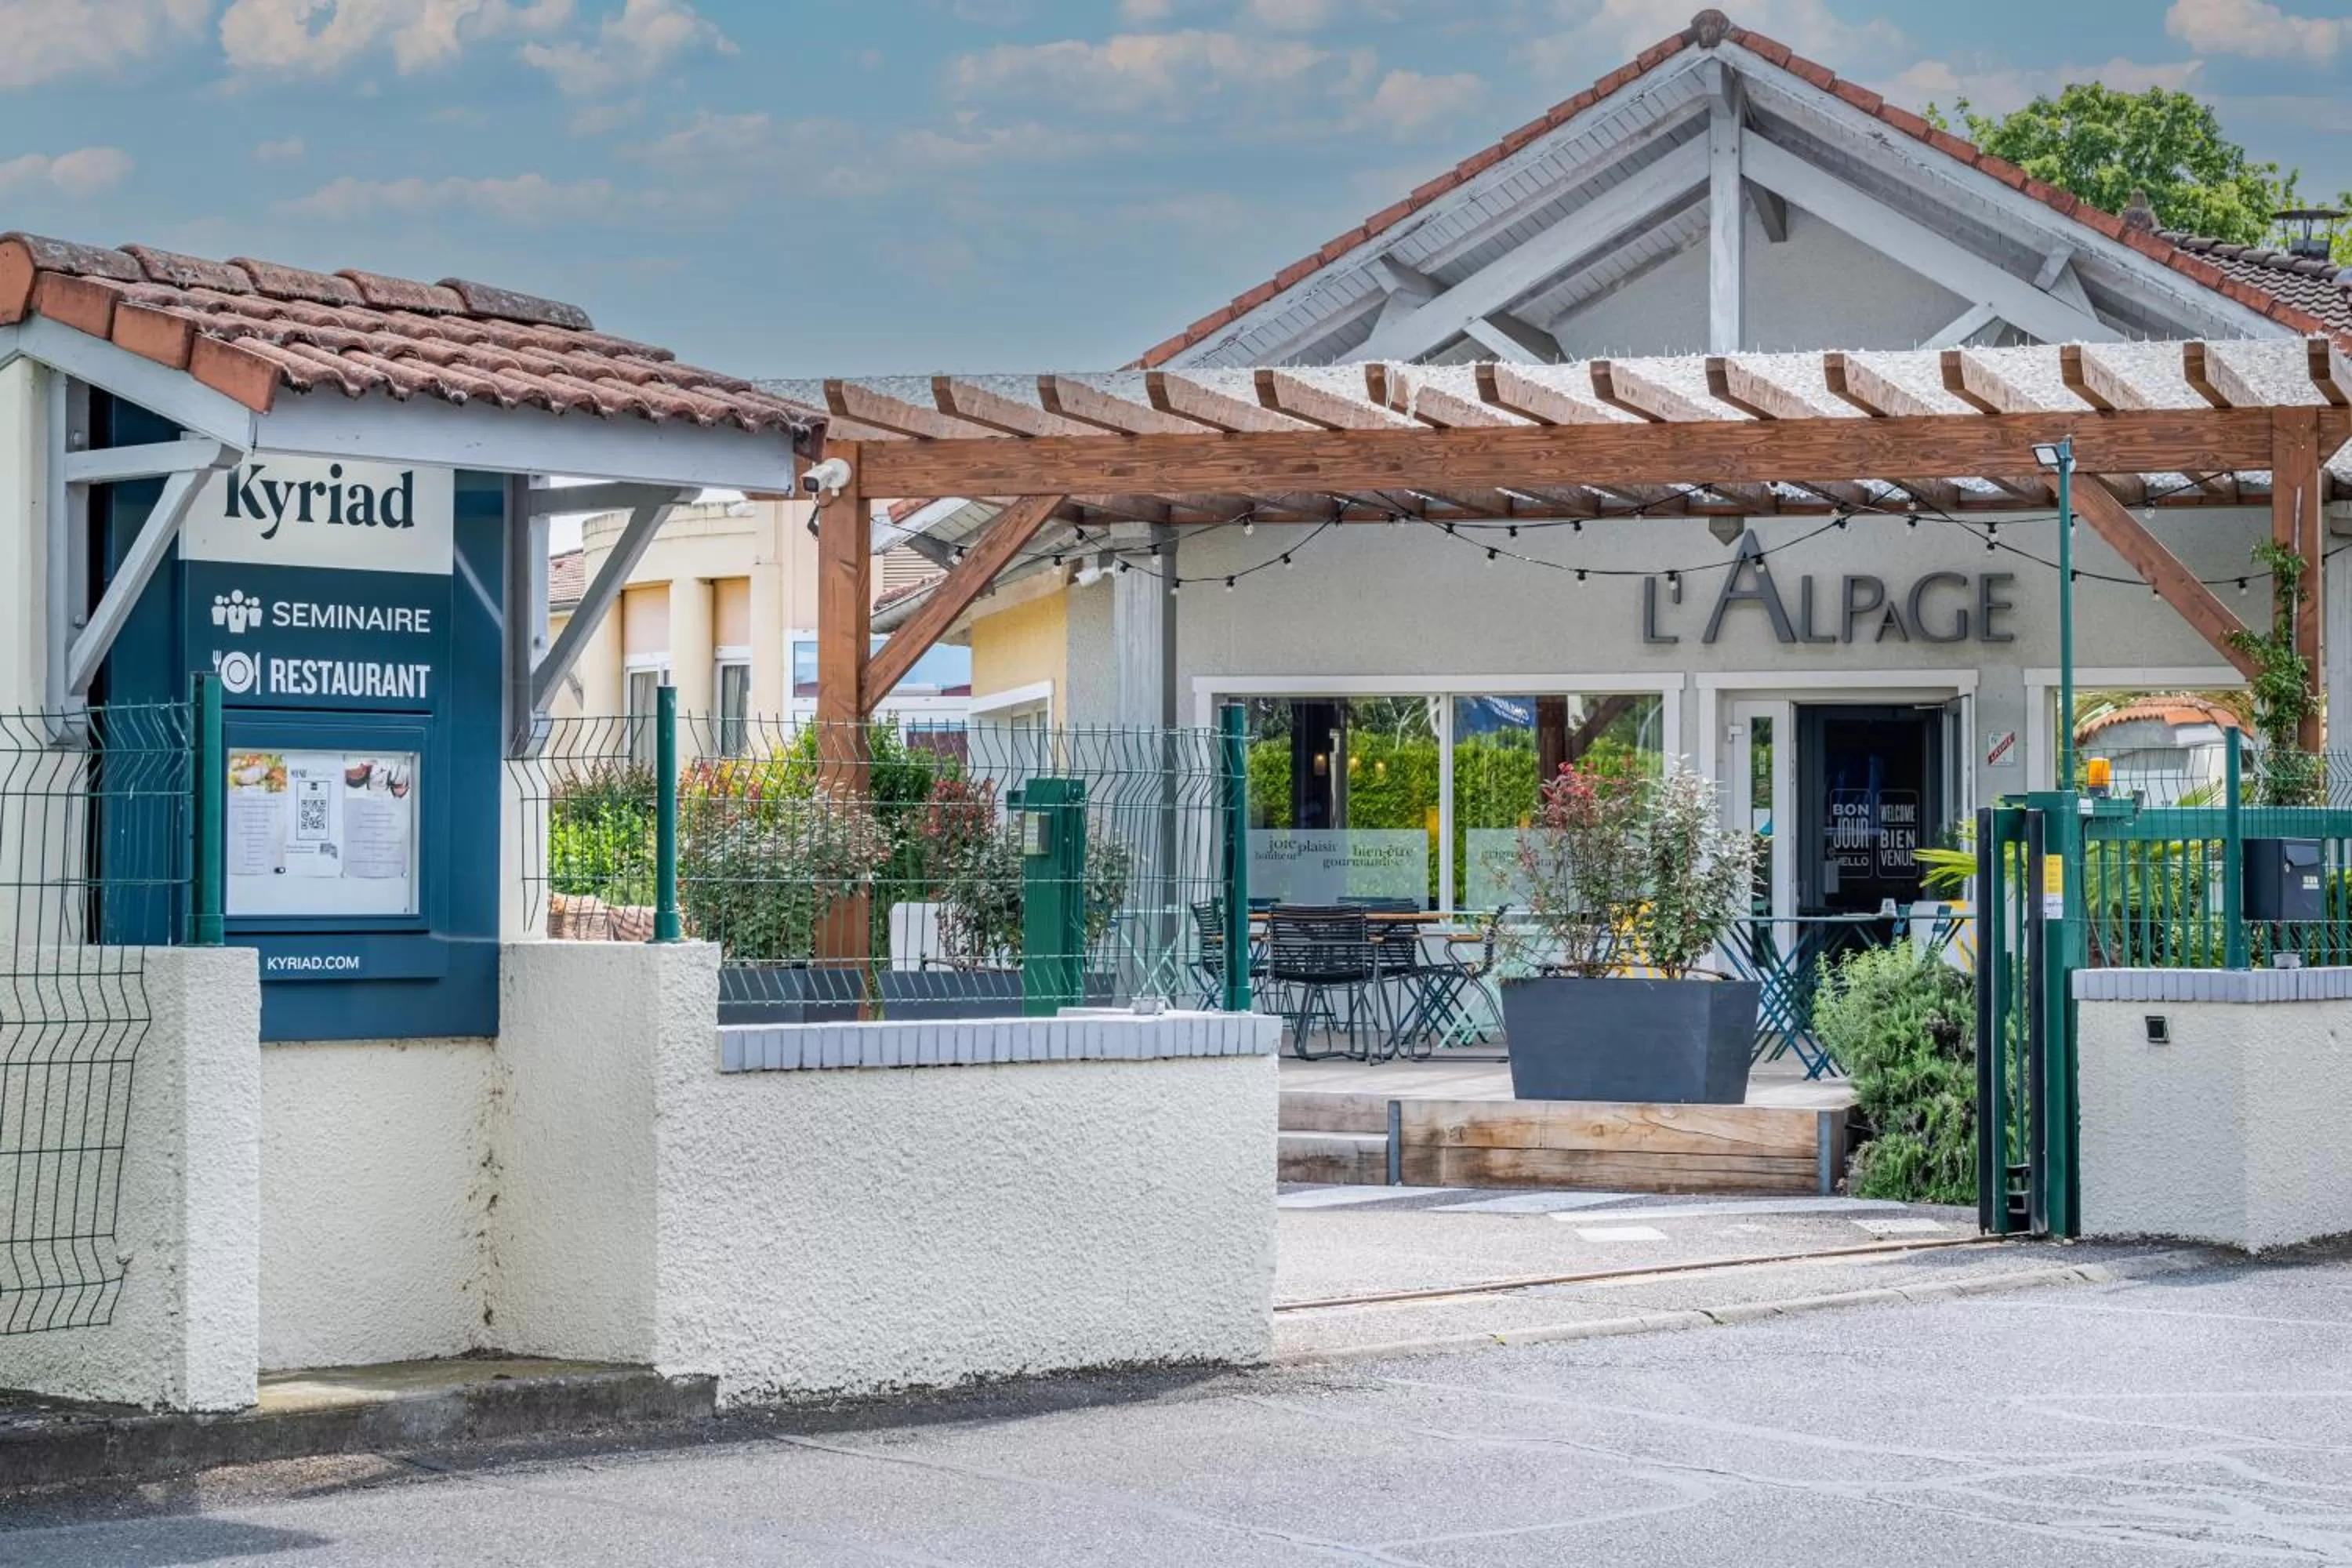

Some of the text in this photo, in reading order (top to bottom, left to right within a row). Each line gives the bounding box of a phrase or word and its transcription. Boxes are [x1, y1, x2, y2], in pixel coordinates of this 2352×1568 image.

[224, 463, 415, 540] Kyriad
[272, 601, 431, 633] SEMINAIRE
[270, 659, 430, 699] RESTAURANT
[1832, 804, 1869, 815] BON
[1881, 804, 1915, 822] WELCOME
[1833, 818, 1869, 849] JOUR
[1882, 829, 1915, 848] BIEN
[1298, 840, 1339, 856] plaisir
[267, 956, 360, 970] KYRIAD.COM
